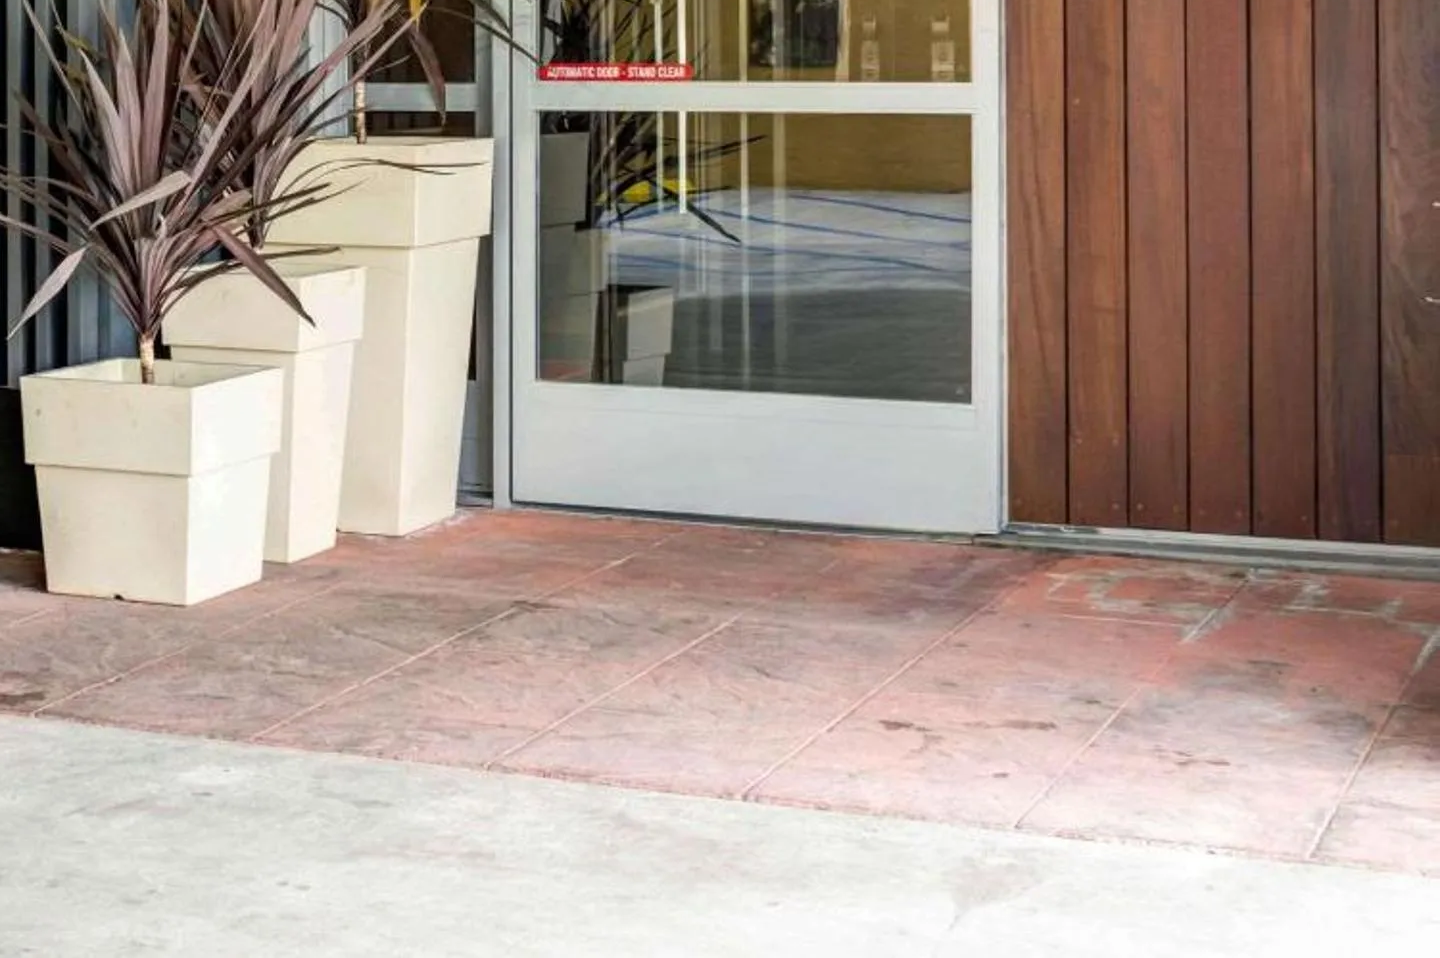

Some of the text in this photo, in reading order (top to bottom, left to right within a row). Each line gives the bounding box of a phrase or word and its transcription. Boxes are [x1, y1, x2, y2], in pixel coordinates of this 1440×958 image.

[547, 66, 595, 78] AUTOMATIC
[596, 66, 620, 78] DOOR
[627, 66, 656, 78] STAND
[658, 66, 686, 78] CLEAR
